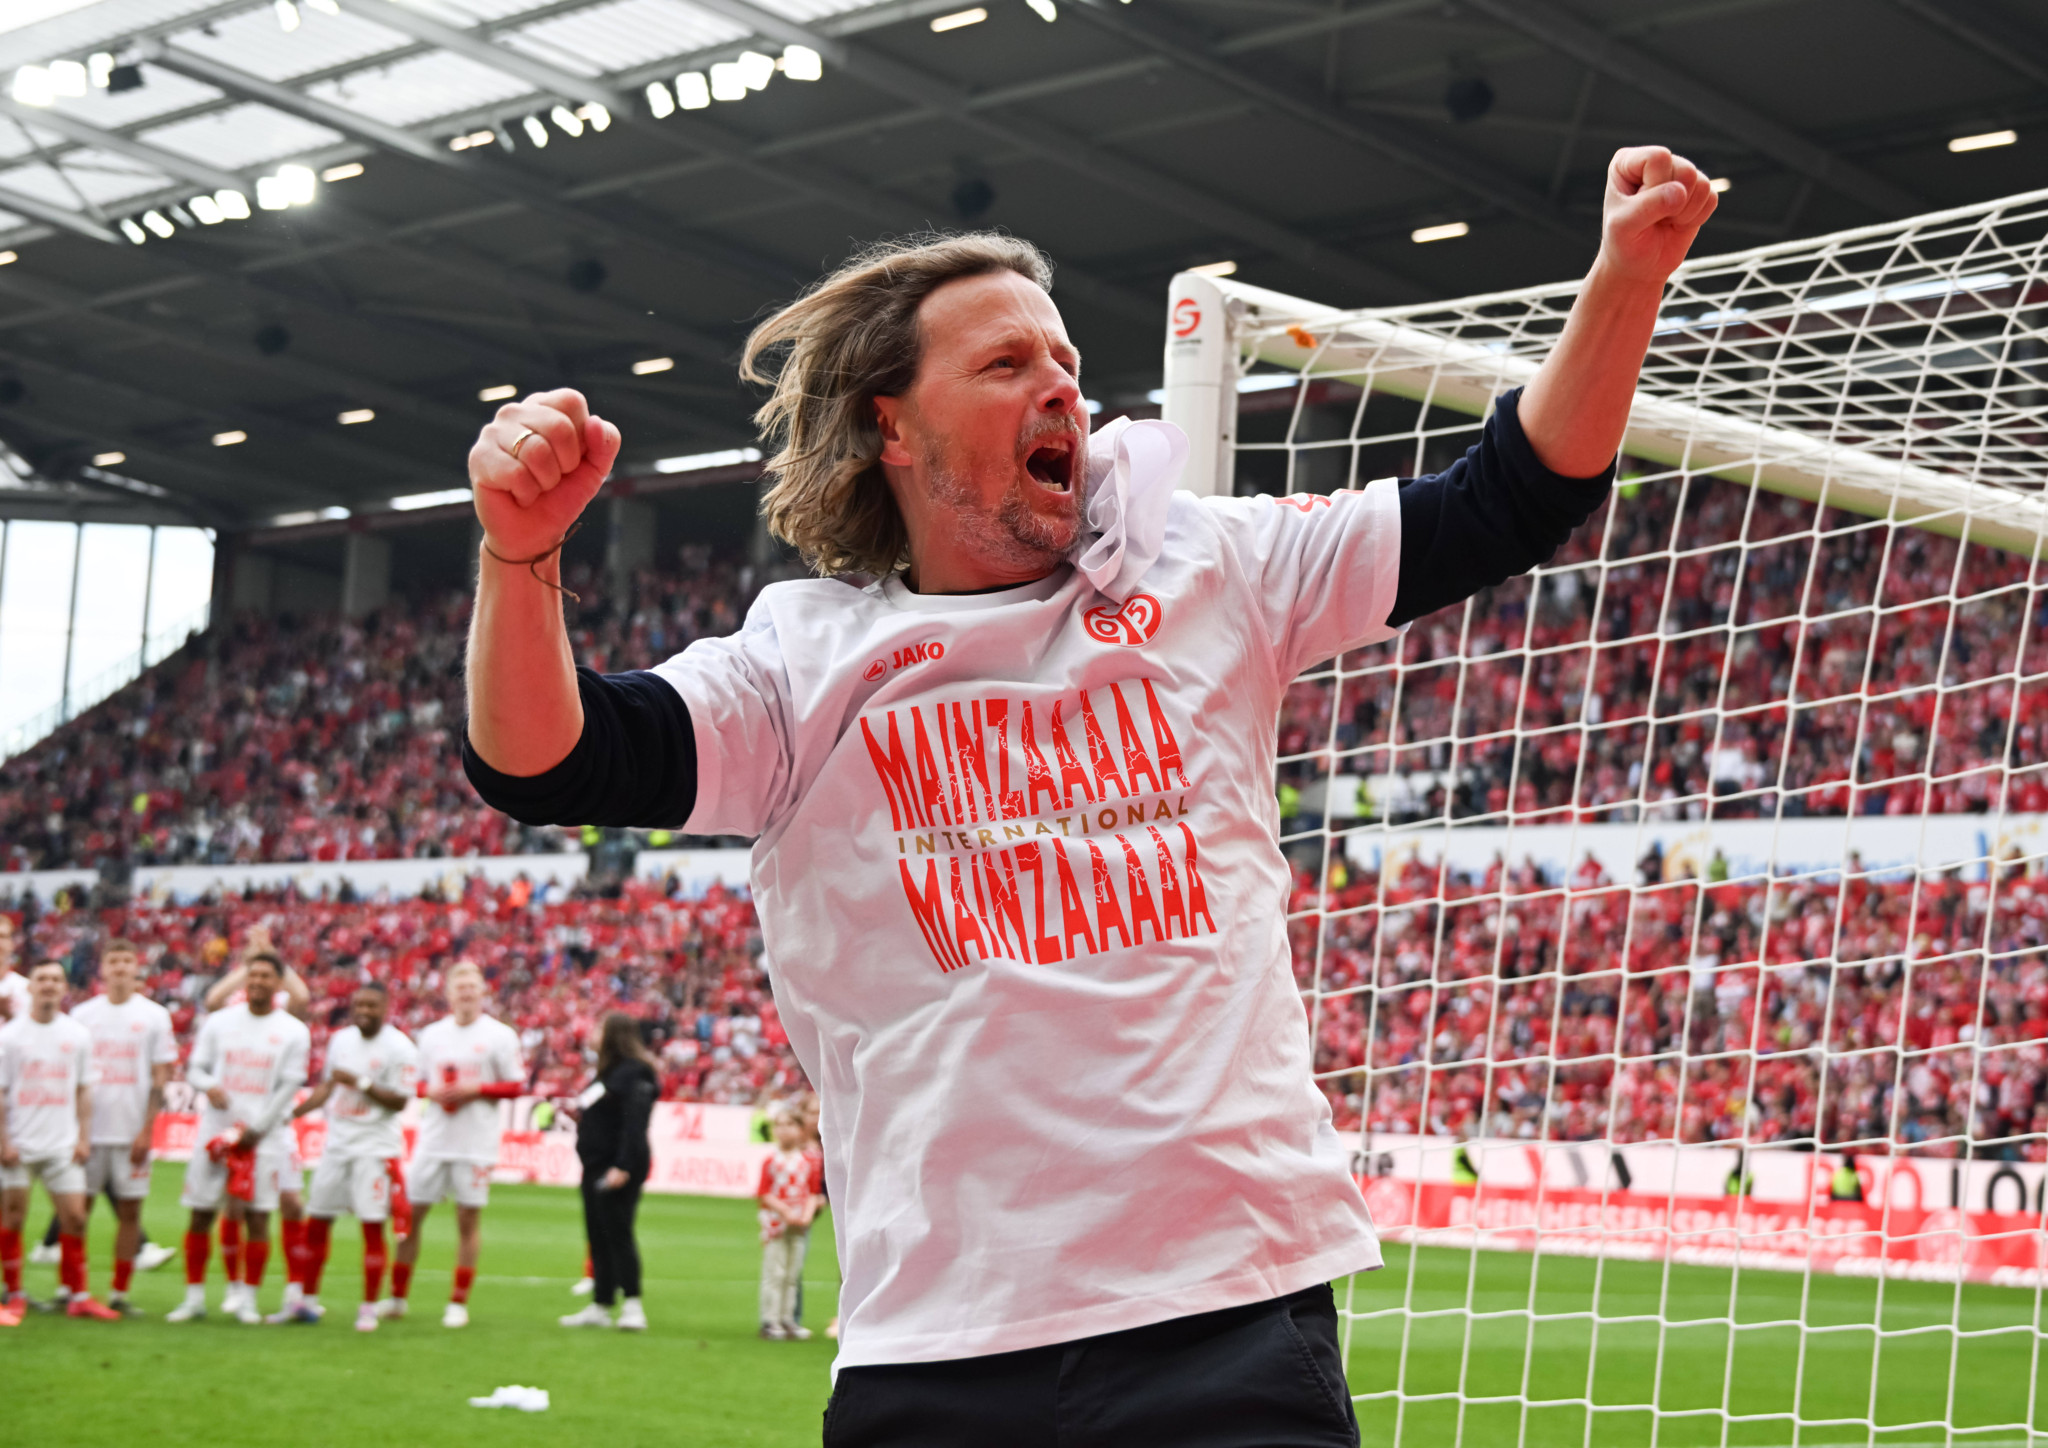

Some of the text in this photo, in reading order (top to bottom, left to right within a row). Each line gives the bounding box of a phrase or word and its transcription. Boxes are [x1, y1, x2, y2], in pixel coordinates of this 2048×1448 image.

[892, 641, 945, 670] JAKO
[860, 678, 1191, 832] MAINZAAAAA
[898, 796, 1189, 855] INTERNATIONAL
[899, 821, 1217, 973] MAINZAAAAA
